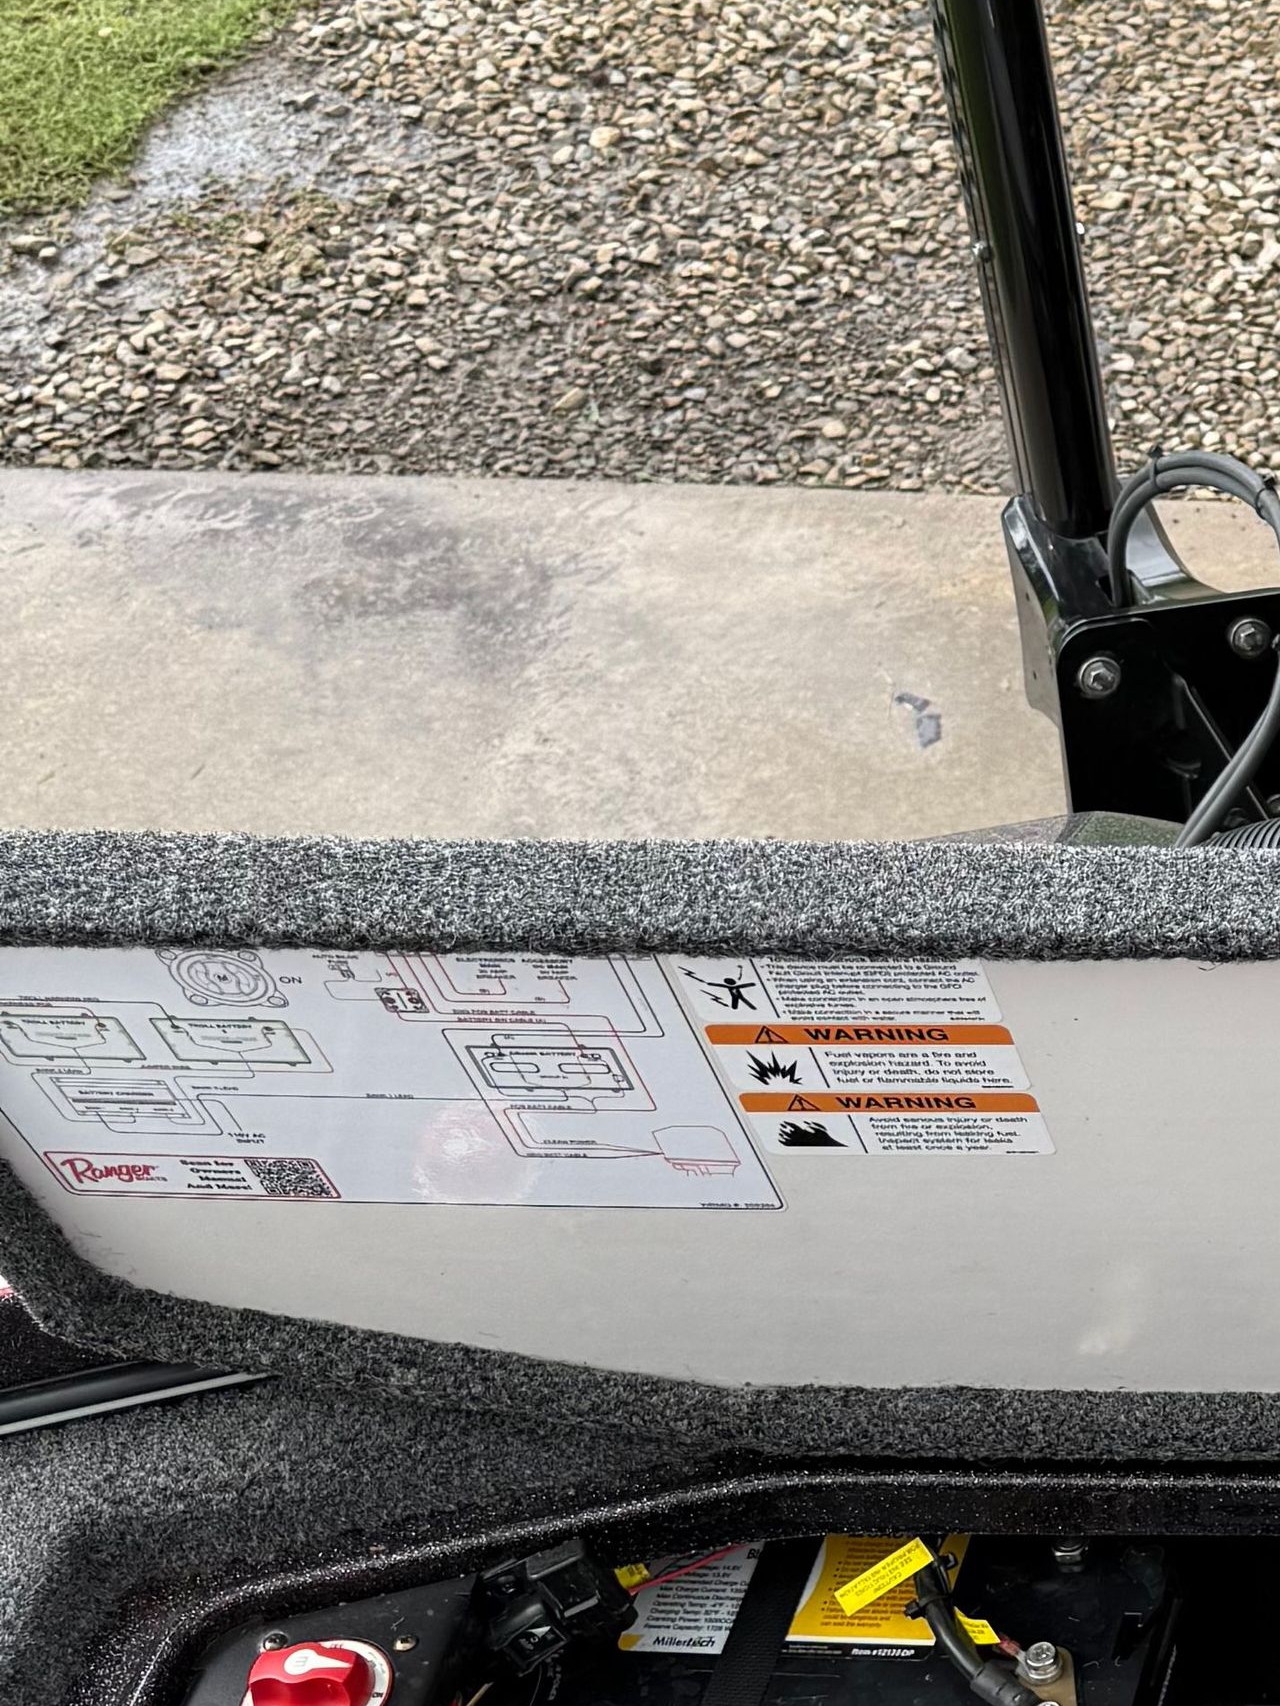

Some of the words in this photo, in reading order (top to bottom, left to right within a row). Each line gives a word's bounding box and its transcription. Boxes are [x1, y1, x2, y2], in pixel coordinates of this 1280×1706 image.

[280, 976, 302, 984] ON
[804, 1028, 949, 1041] WARNING
[836, 1097, 977, 1109] WARNING
[61, 1157, 157, 1183] Ranger
